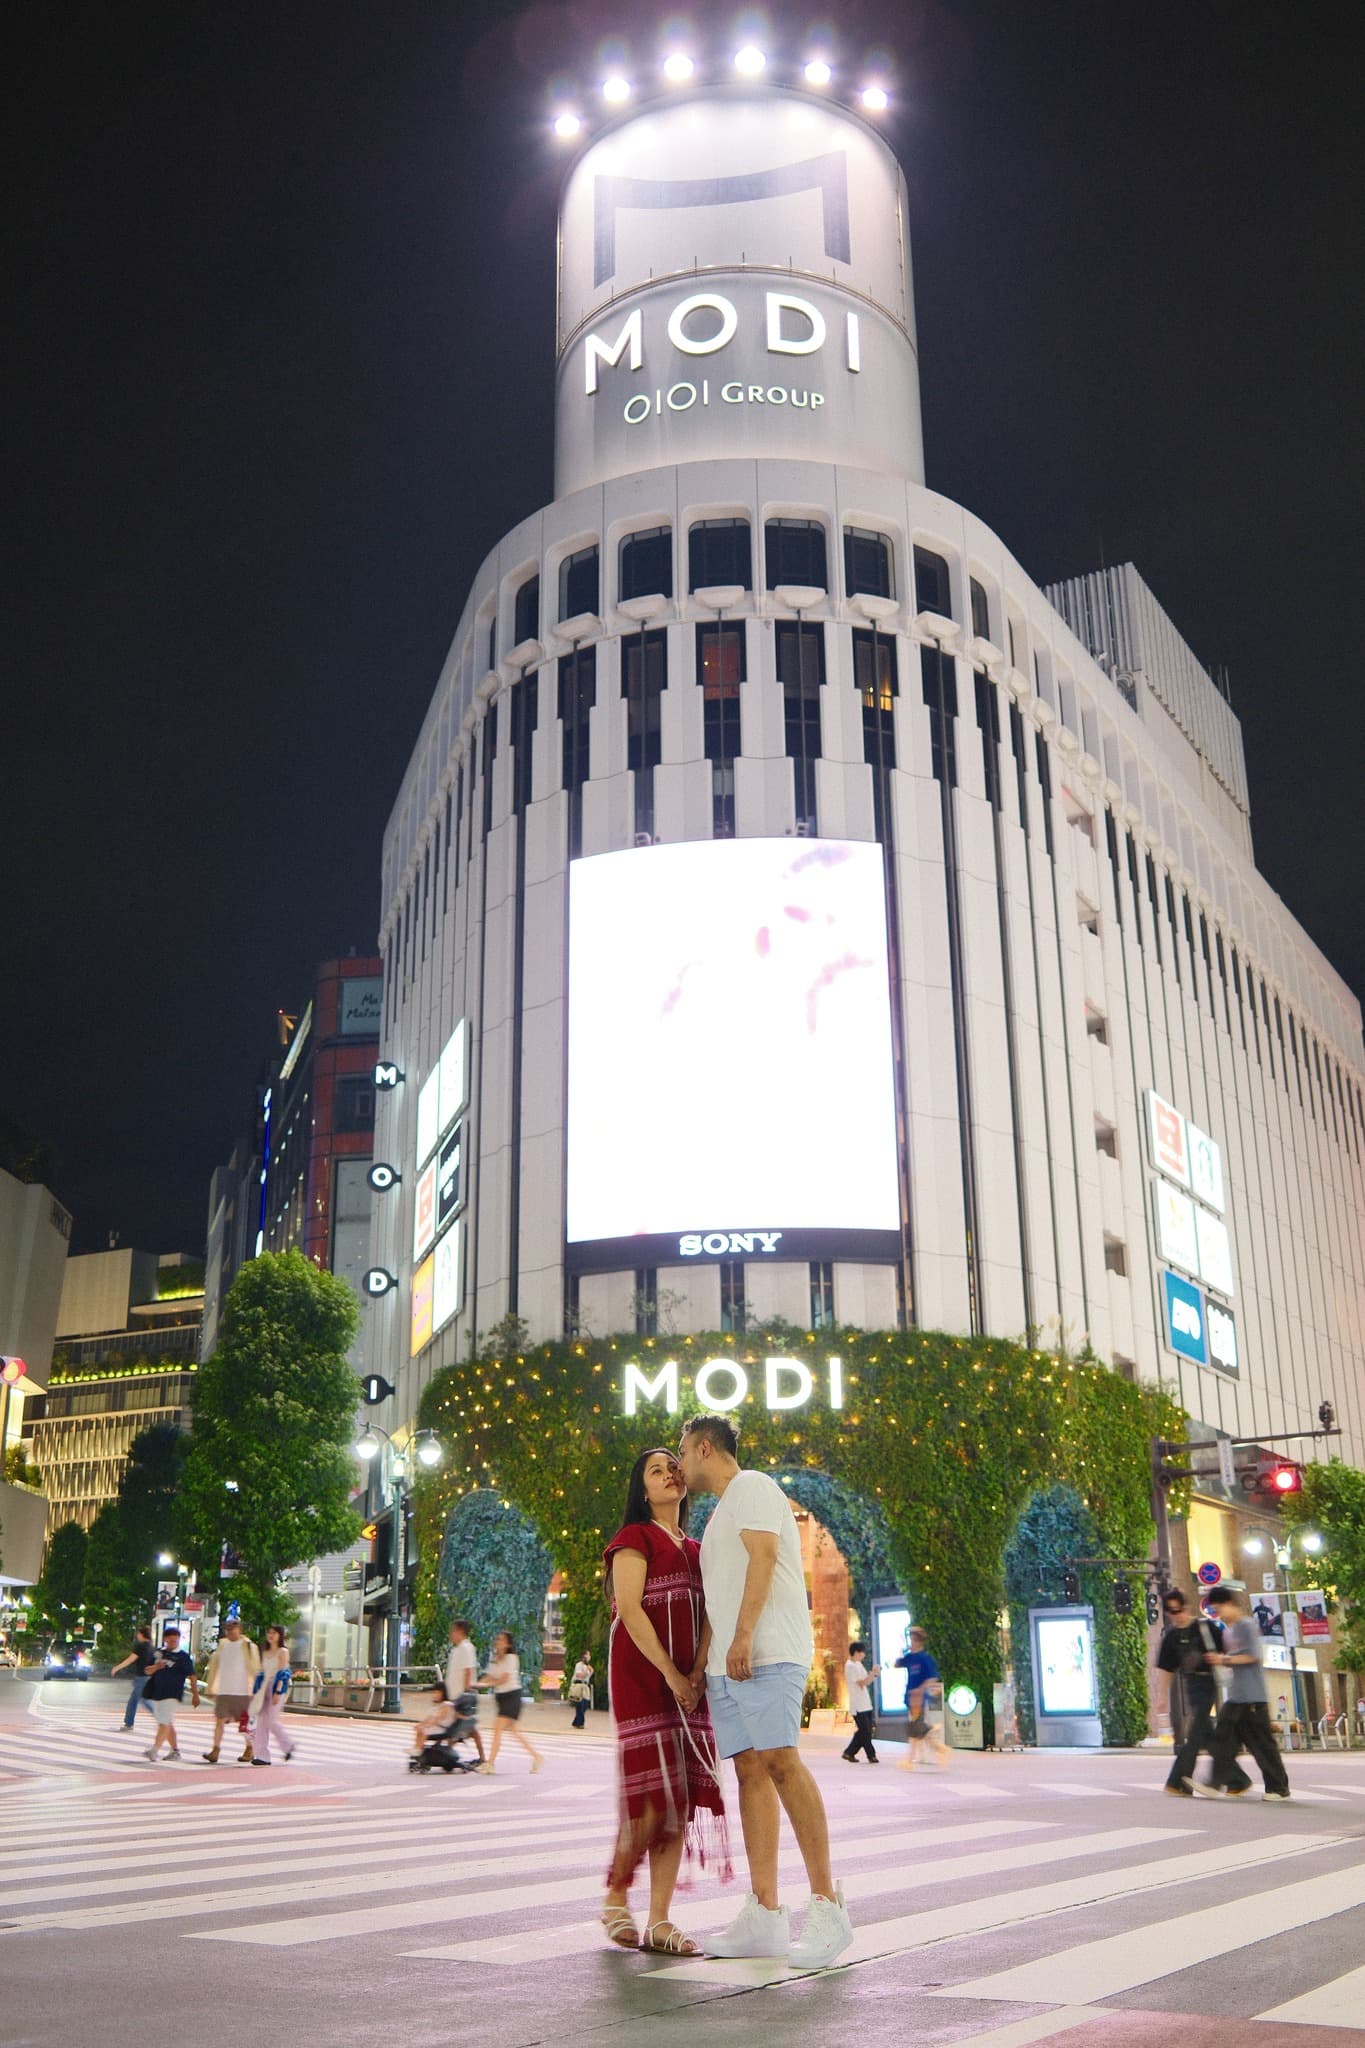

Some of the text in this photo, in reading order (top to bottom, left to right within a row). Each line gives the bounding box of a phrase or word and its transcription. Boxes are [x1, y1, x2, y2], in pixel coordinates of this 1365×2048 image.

[585, 292, 861, 395] MODI
[721, 382, 825, 409] GROUP
[679, 1232, 782, 1256] SONY
[624, 1357, 842, 1415] MODI
